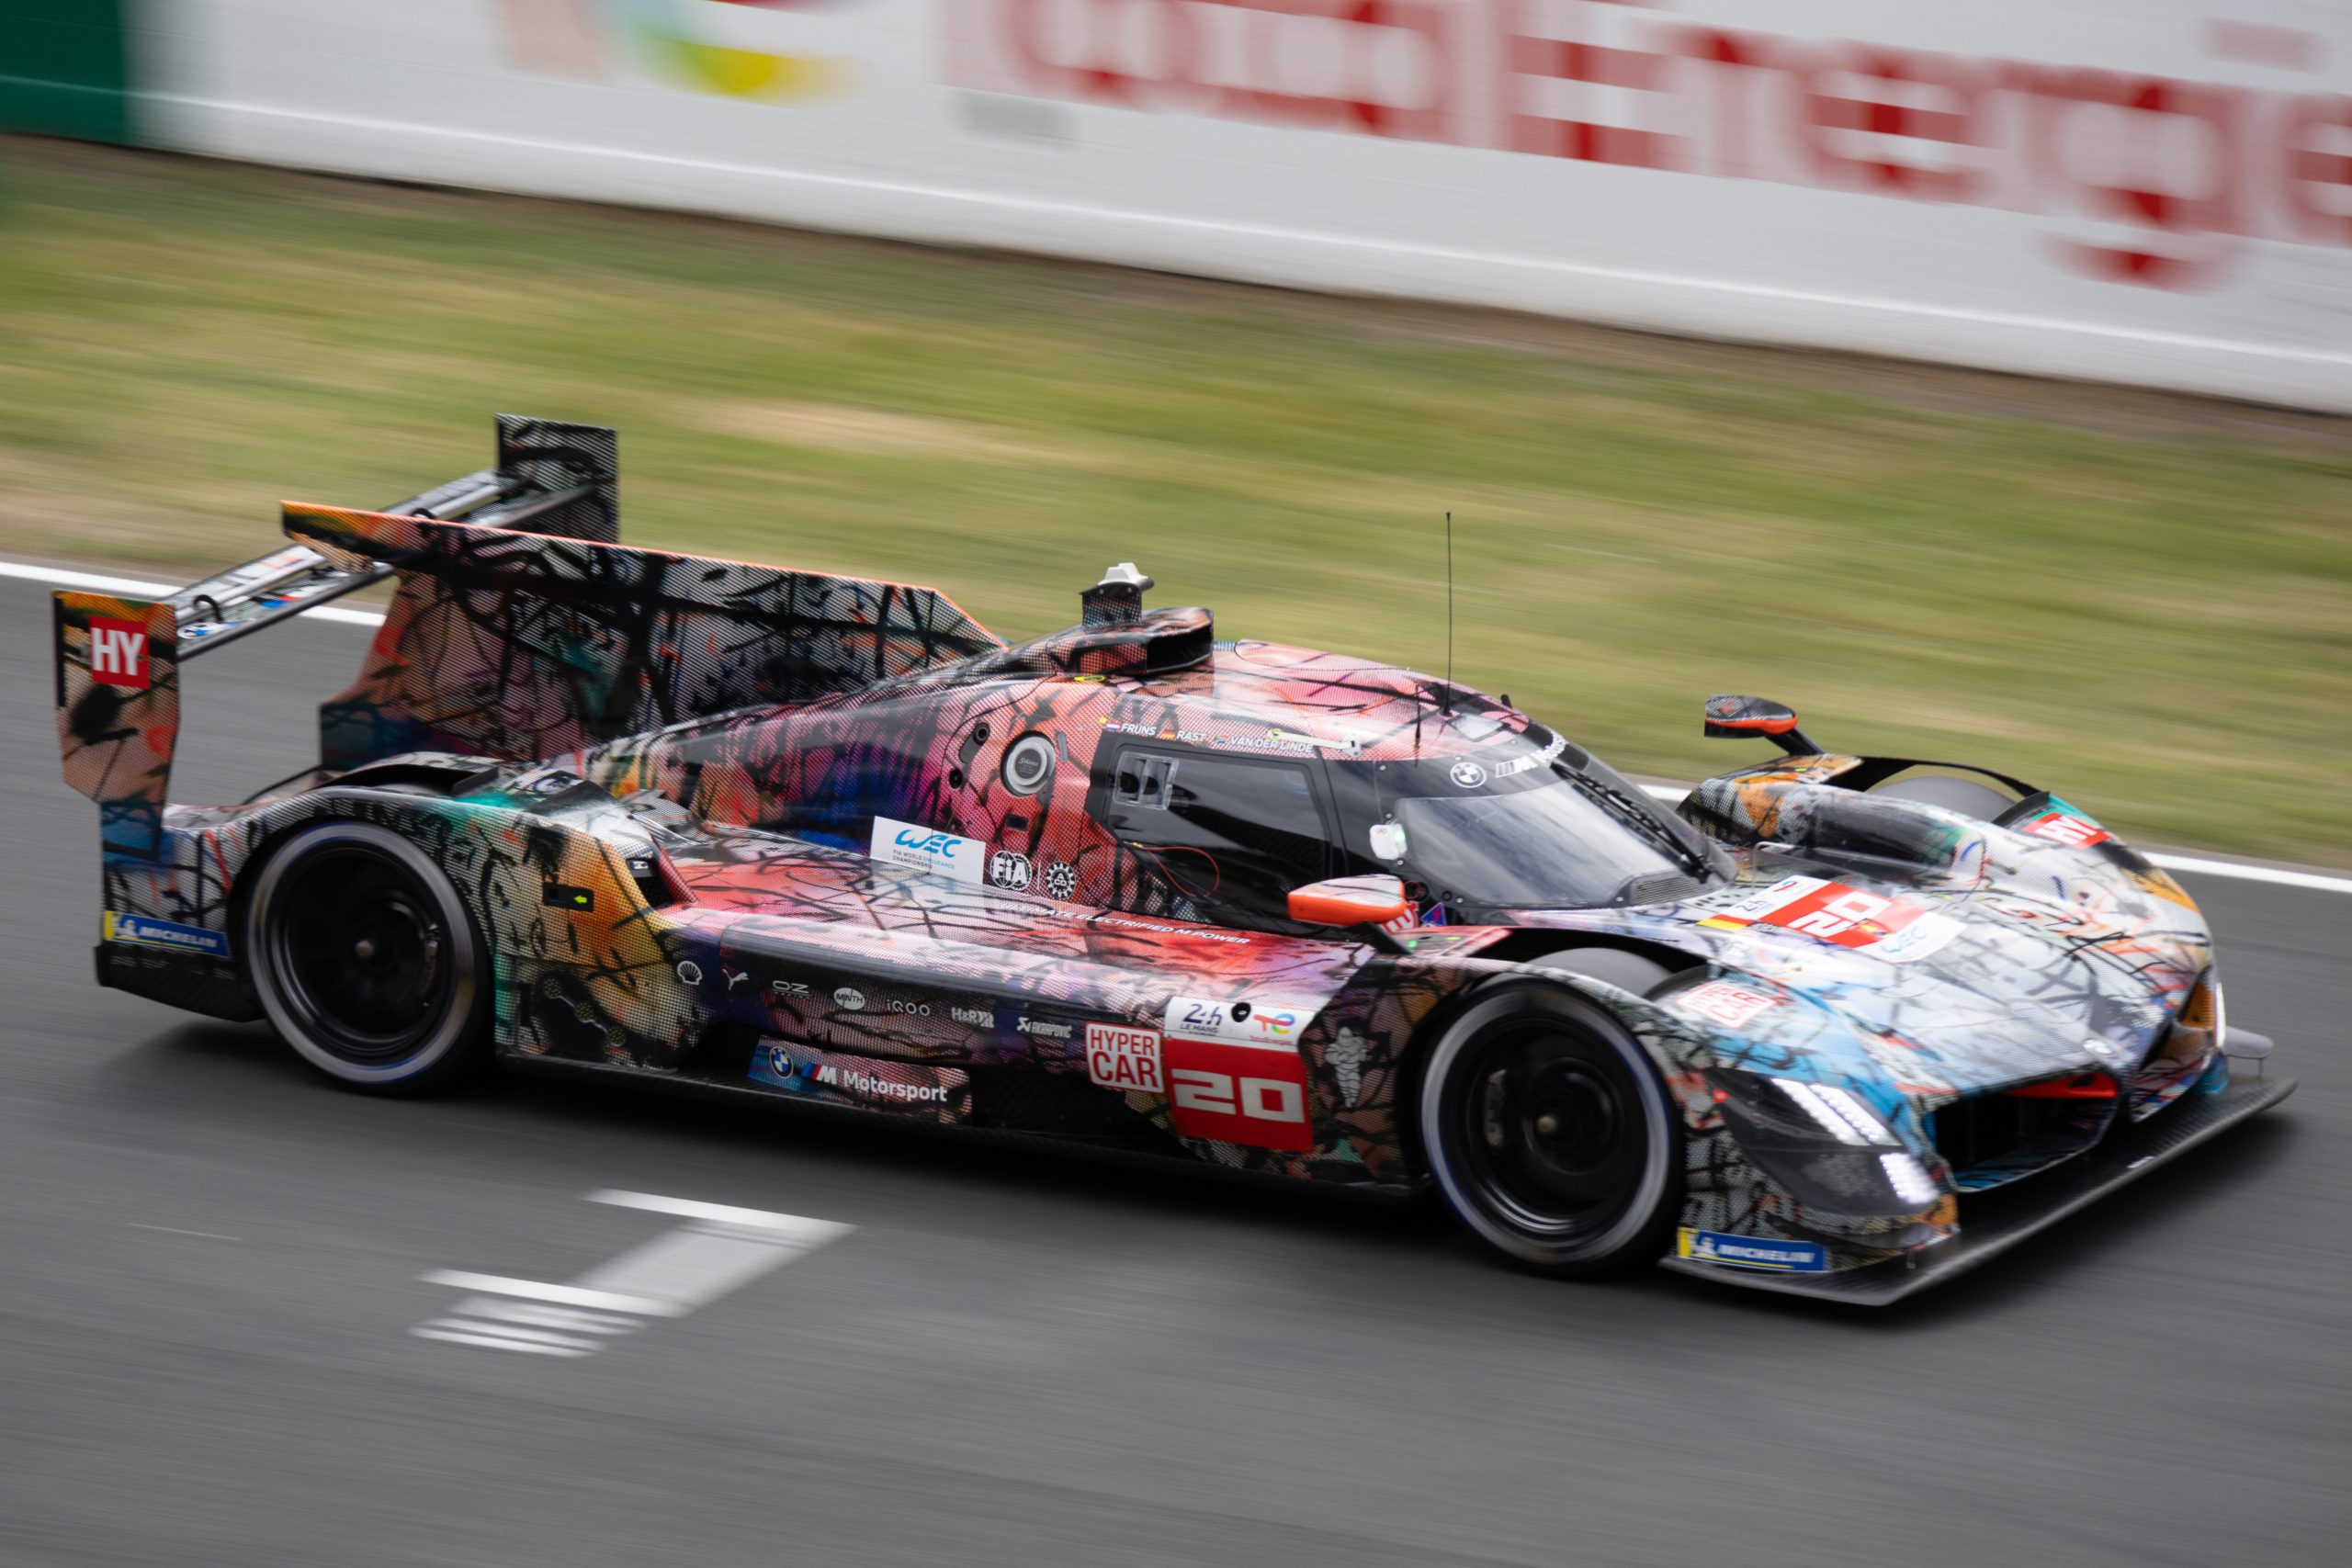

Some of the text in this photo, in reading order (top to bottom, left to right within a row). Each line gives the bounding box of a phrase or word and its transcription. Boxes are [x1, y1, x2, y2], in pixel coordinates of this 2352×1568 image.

[91, 626, 146, 676] HY
[1177, 730, 1205, 743] RAST
[1230, 737, 1257, 749] VAN
[1257, 739, 1278, 751] DER
[1280, 740, 1314, 755] LINDE
[895, 829, 963, 858] WEC
[2034, 816, 2097, 845] HY
[903, 852, 922, 861] WORLD
[1079, 911, 1175, 932] ELECTRIFIED
[1192, 930, 1250, 944] POWER
[1785, 891, 1894, 938] 20
[139, 926, 219, 948] MICHELIN
[887, 998, 931, 1017] iQOO
[1182, 1003, 1223, 1027] 24h
[1193, 1023, 1219, 1033] MANS
[1091, 1029, 1155, 1056] HYPER
[1092, 1051, 1159, 1089] CAR
[842, 1070, 948, 1102] Motorsport
[1171, 1068, 1306, 1123] 20
[1717, 1244, 1815, 1263] MICHELIN
